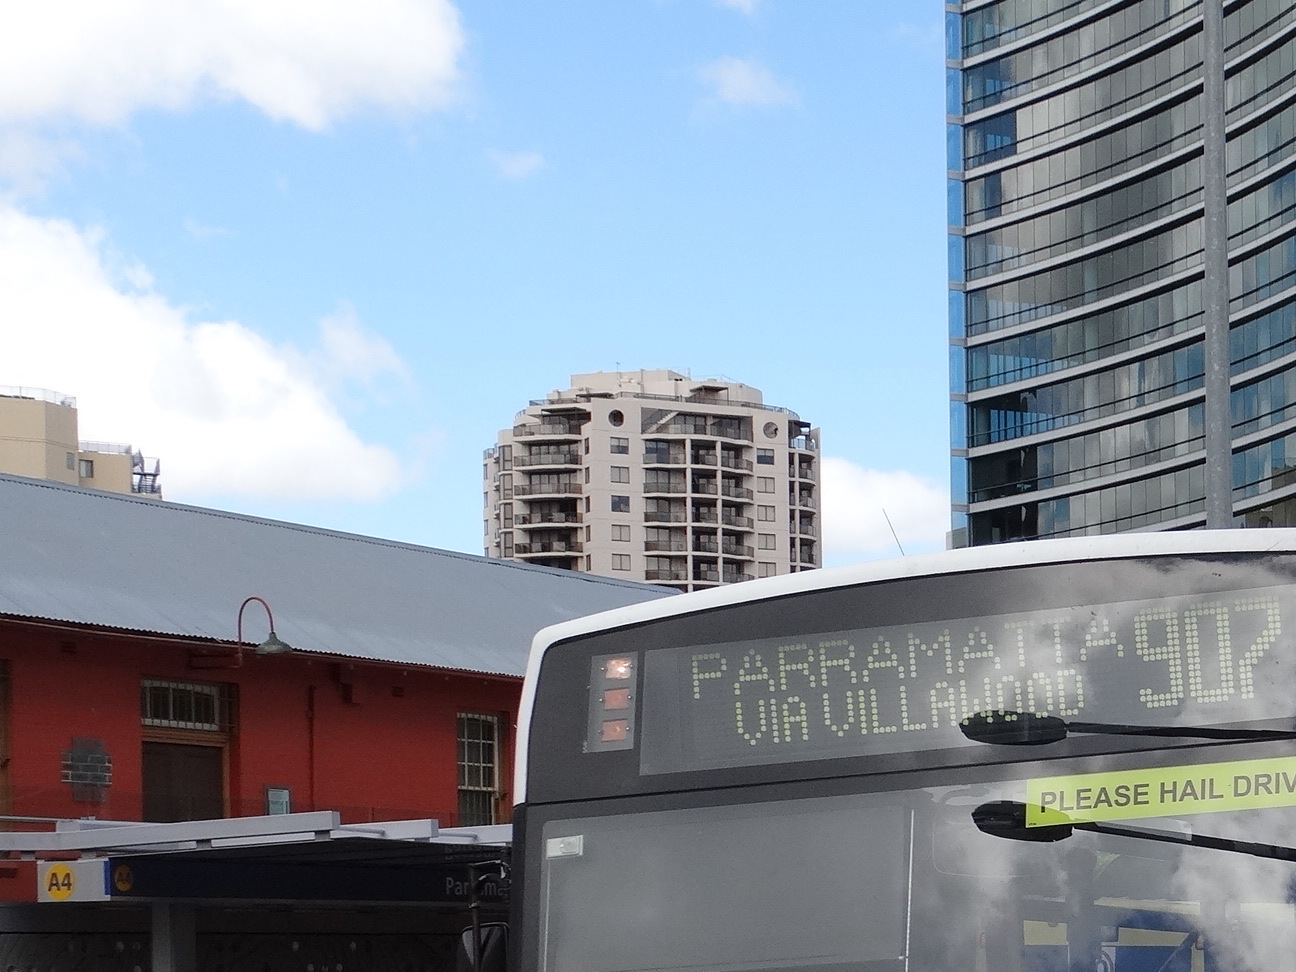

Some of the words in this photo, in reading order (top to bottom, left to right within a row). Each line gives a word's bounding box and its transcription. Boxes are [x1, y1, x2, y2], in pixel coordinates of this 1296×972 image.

[691, 617, 1125, 700] PARRAMATTA
[1133, 595, 1283, 709] 907
[734, 695, 809, 746] VIA
[823, 668, 1085, 737] VILLAWOOD
[1040, 782, 1150, 813] PLEASE
[1159, 777, 1224, 804] HAIL
[47, 872, 72, 892] A4
